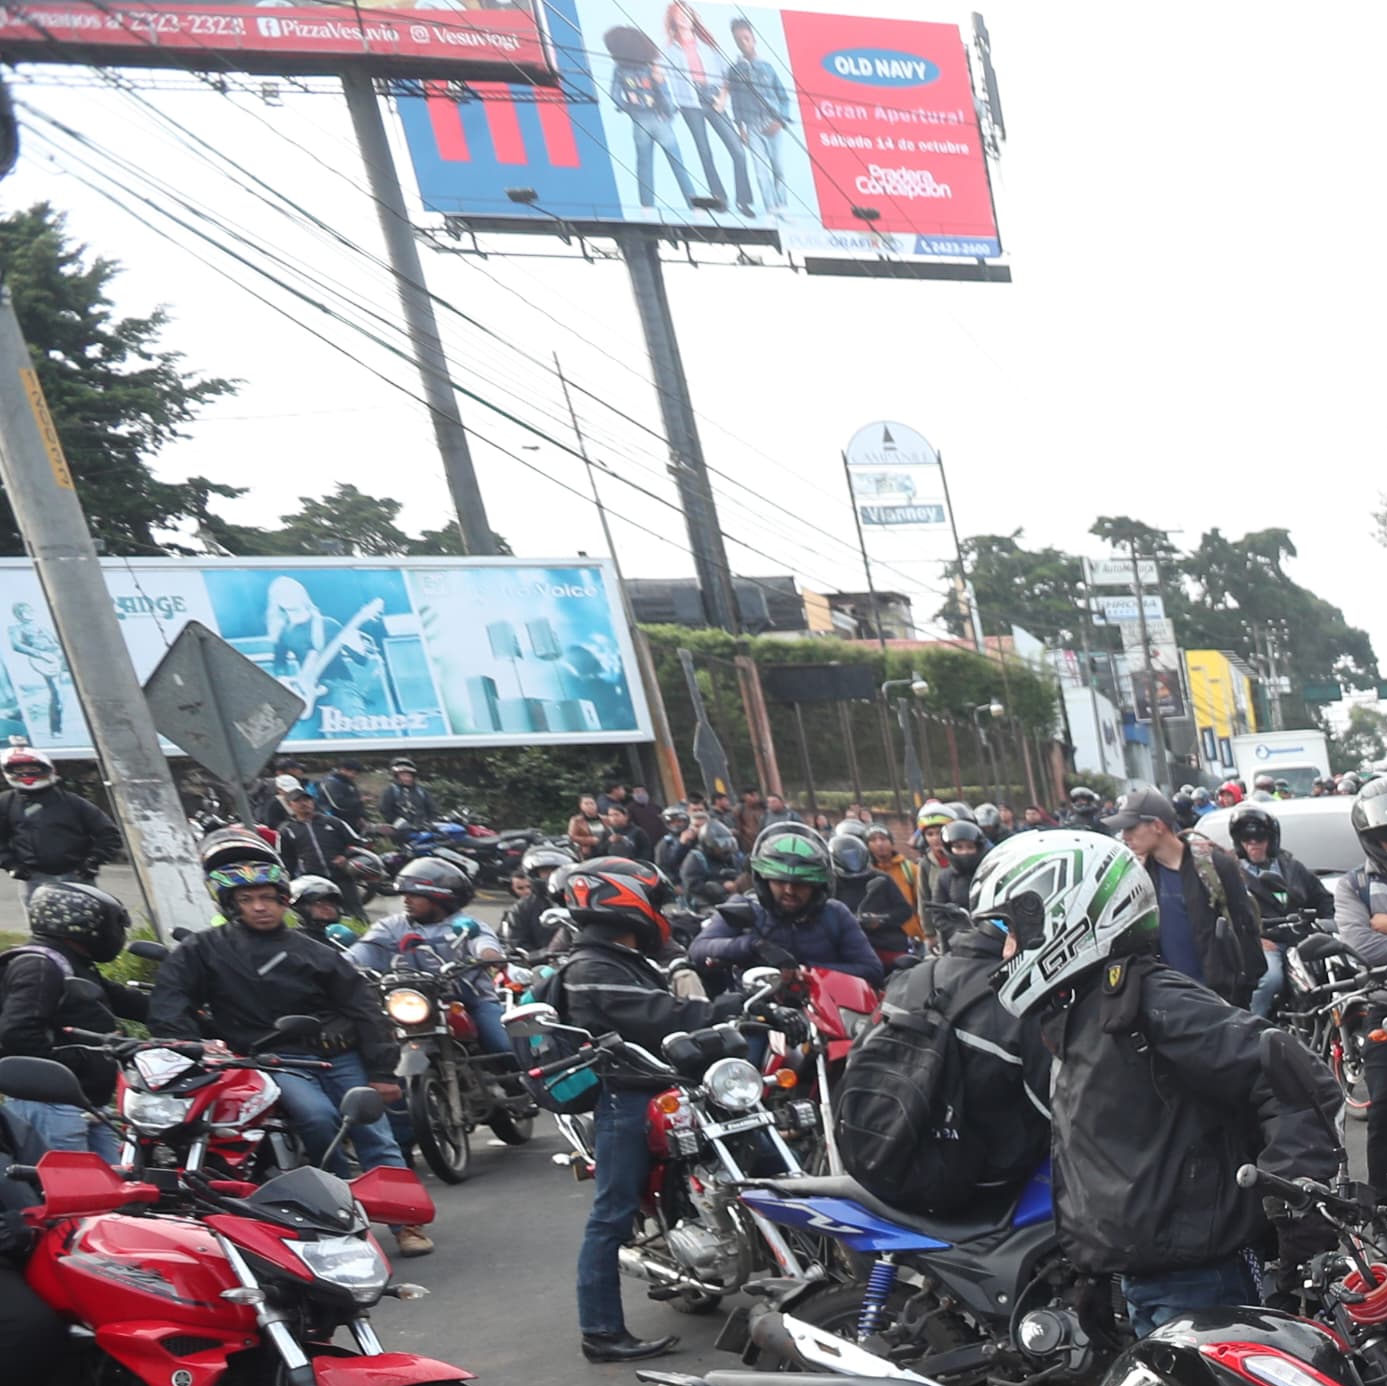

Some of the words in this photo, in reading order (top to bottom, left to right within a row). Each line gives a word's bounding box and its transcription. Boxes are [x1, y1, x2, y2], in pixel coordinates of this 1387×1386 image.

[834, 56, 873, 77] OLD
[874, 58, 927, 81] NAVY
[898, 138, 915, 151] de
[918, 138, 970, 155] octubre
[317, 704, 432, 732] Ibanez
